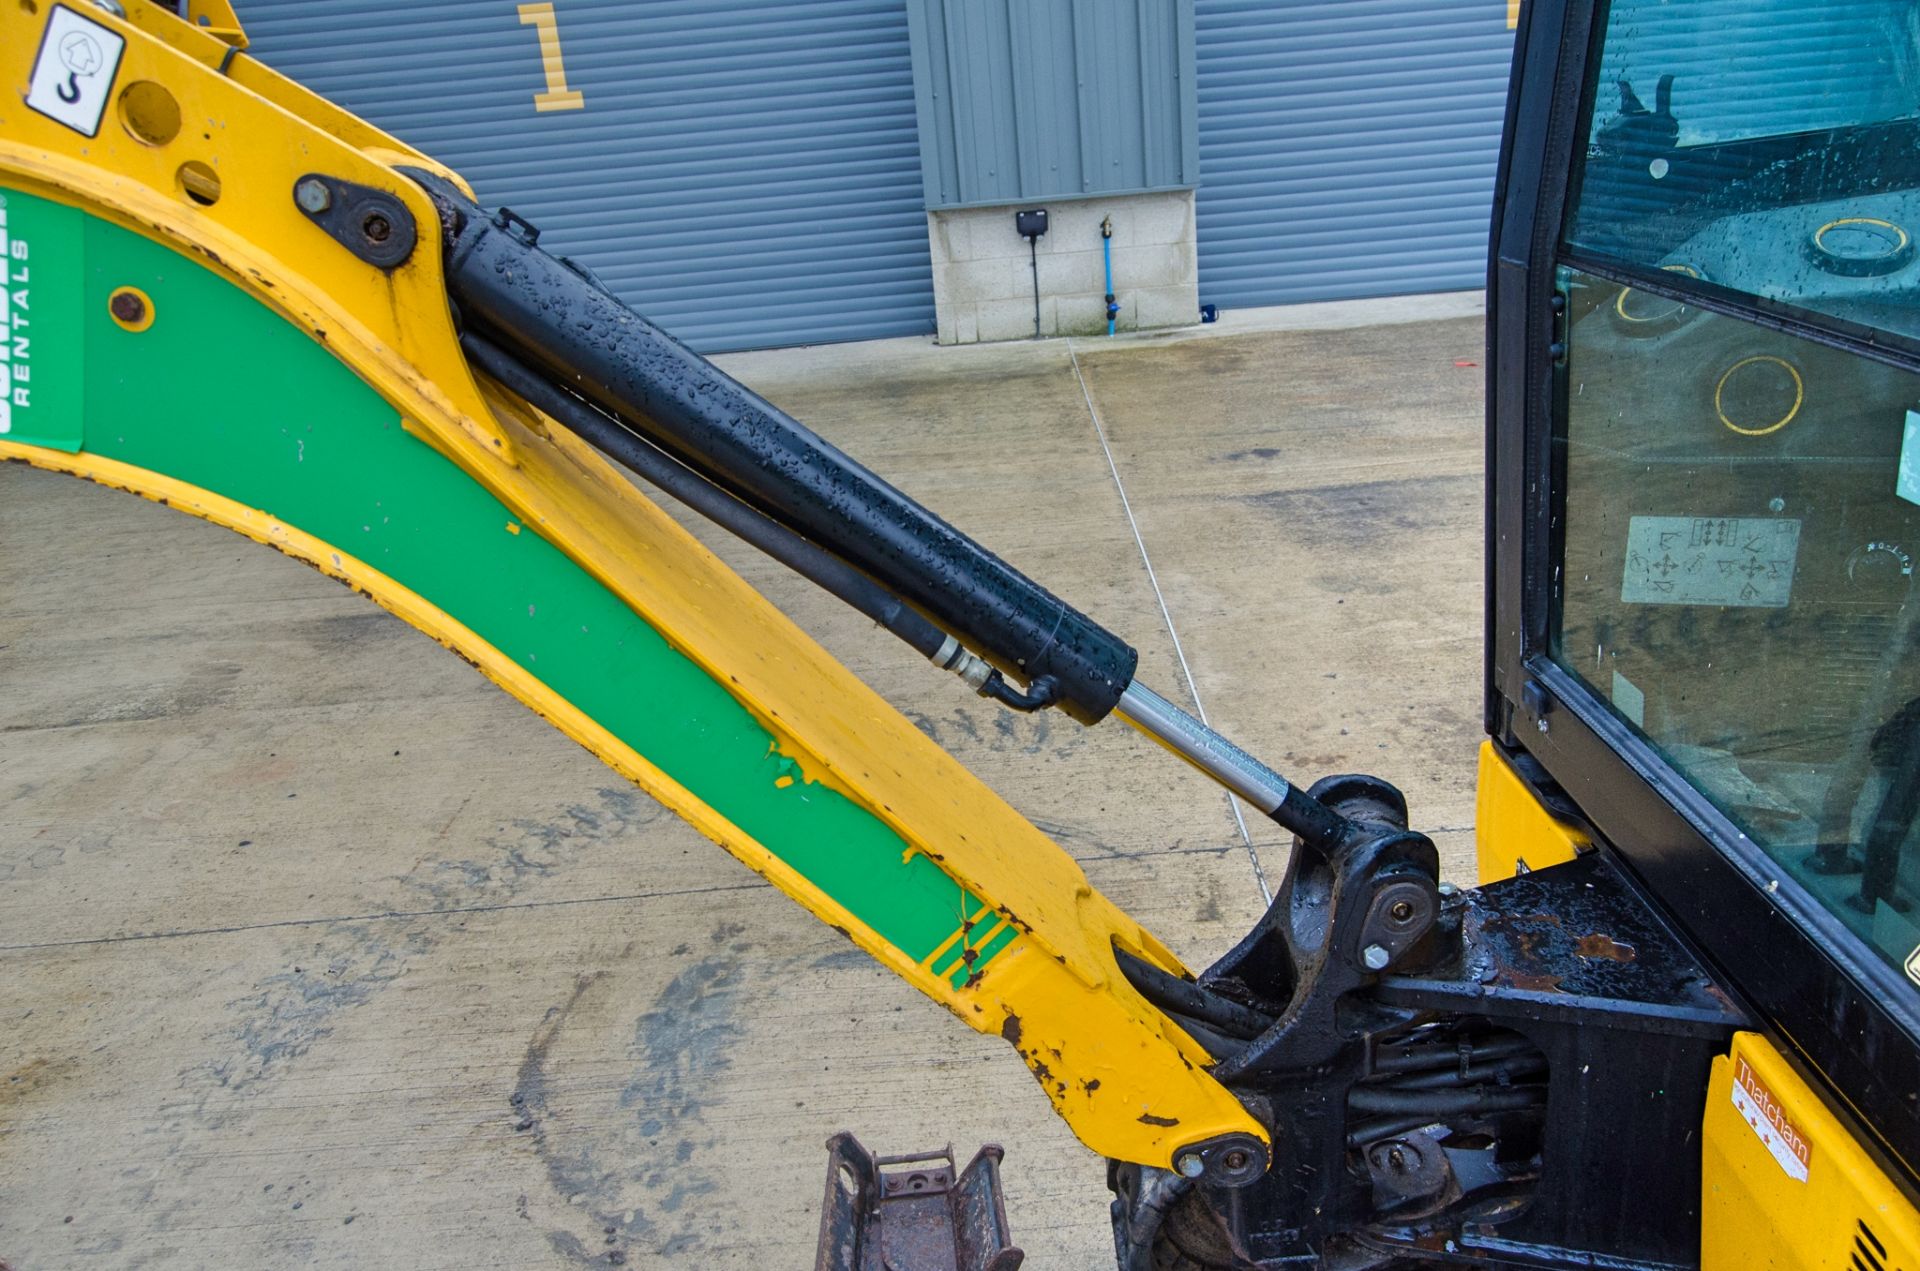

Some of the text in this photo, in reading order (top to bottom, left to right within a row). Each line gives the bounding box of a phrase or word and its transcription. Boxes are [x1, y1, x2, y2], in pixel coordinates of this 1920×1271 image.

[517, 2, 584, 112] 1
[11, 239, 30, 408] RENTALS
[1739, 1057, 1807, 1163] Thatcham
